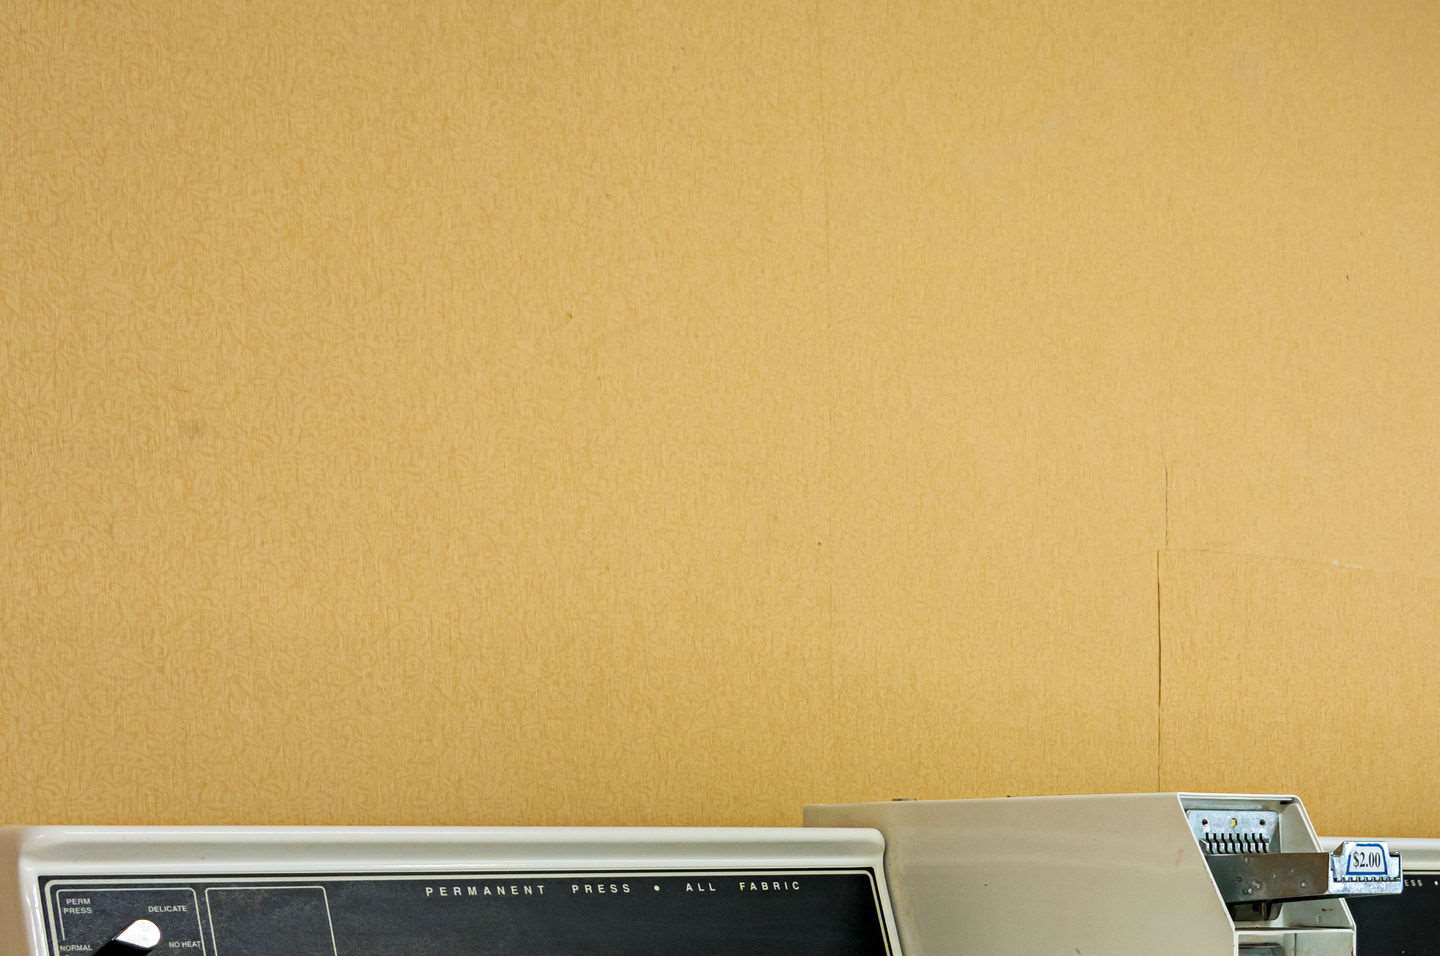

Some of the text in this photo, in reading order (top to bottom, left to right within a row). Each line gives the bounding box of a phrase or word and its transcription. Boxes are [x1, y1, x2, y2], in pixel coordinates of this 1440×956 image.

[1353, 851, 1381, 868] $2.00
[425, 881, 801, 896] PERMANENT PRESS ALL FABRIC
[65, 898, 91, 906] PERM
[148, 905, 188, 913] DELICATE
[59, 944, 93, 952] NORMAL
[182, 940, 201, 948] HEAT
